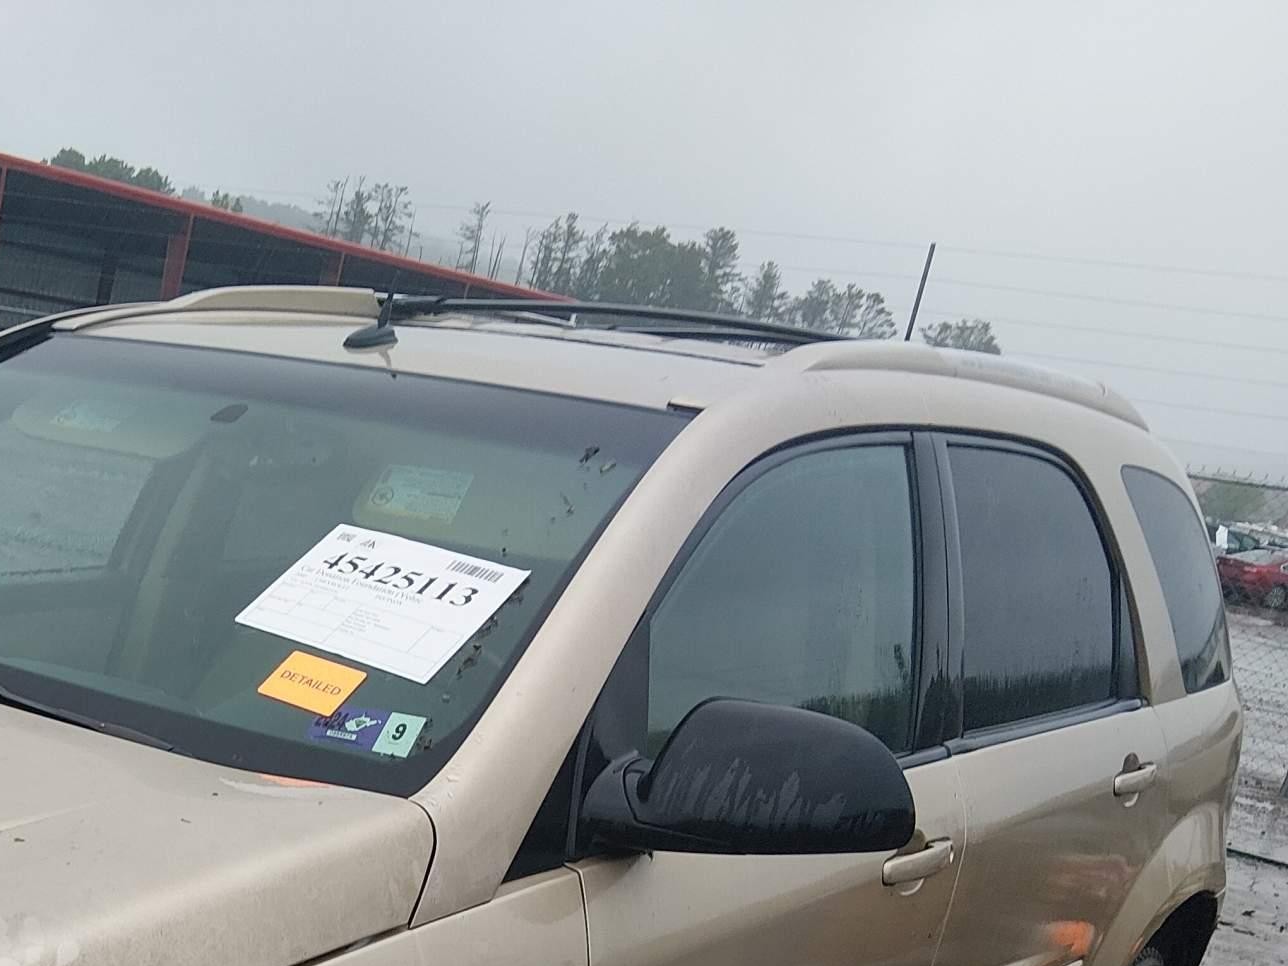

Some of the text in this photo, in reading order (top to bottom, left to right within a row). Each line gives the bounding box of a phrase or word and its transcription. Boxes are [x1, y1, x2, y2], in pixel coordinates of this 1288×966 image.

[323, 552, 479, 607] 45425113
[279, 670, 342, 696] DETAILED
[391, 723, 408, 741] 9
